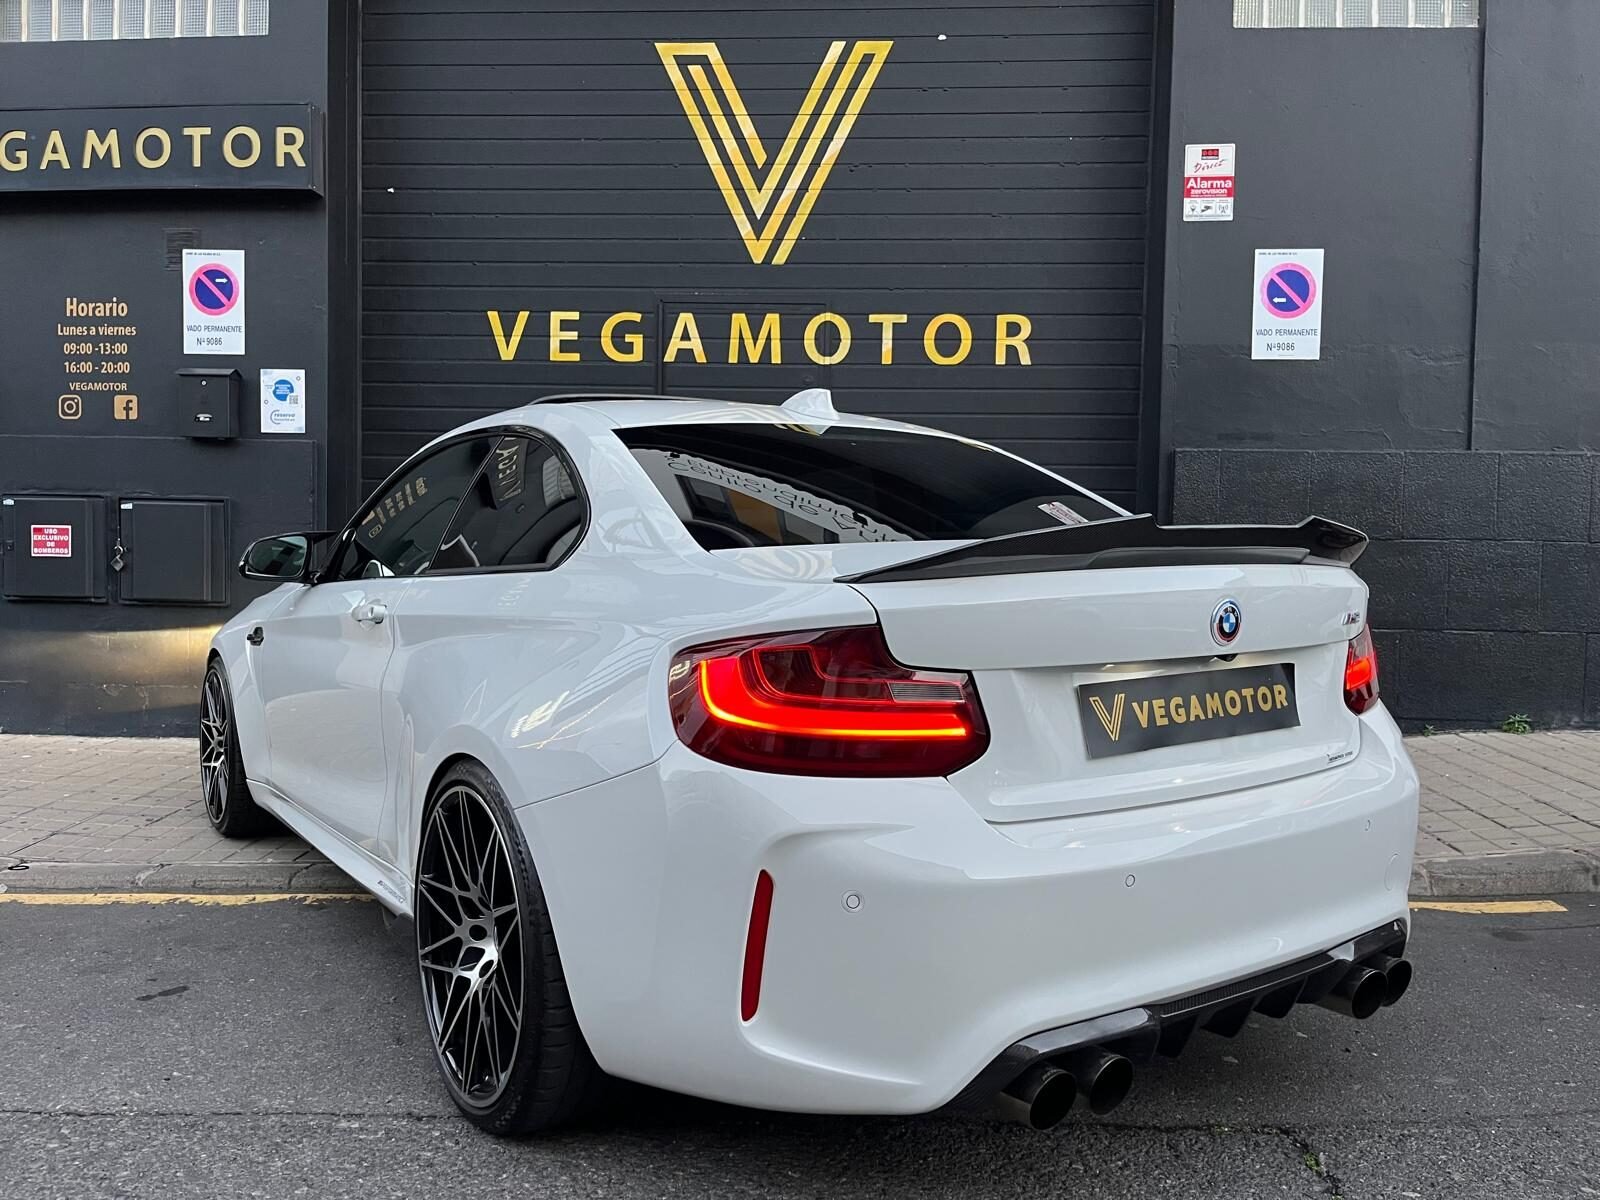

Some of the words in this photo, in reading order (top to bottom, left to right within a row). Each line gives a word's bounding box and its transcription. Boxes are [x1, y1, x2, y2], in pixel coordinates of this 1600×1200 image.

[1187, 178, 1232, 189] Alarma
[66, 297, 128, 317] Horario
[58, 323, 87, 336] Lunes
[90, 326, 96, 336] a
[98, 323, 137, 336] viernes
[187, 325, 202, 333] VADO
[204, 325, 243, 333] PERMANENTE
[1256, 328, 1273, 336] VADO
[1275, 328, 1318, 337] PERMANENTE
[487, 310, 1033, 366] VEGAMOTOR
[63, 342, 93, 355] 09:00
[64, 361, 93, 374] 16:00
[101, 361, 130, 374] 20:00
[69, 382, 128, 391] VEGAMOTOR
[1132, 684, 1288, 728] VEGAMOTOR
